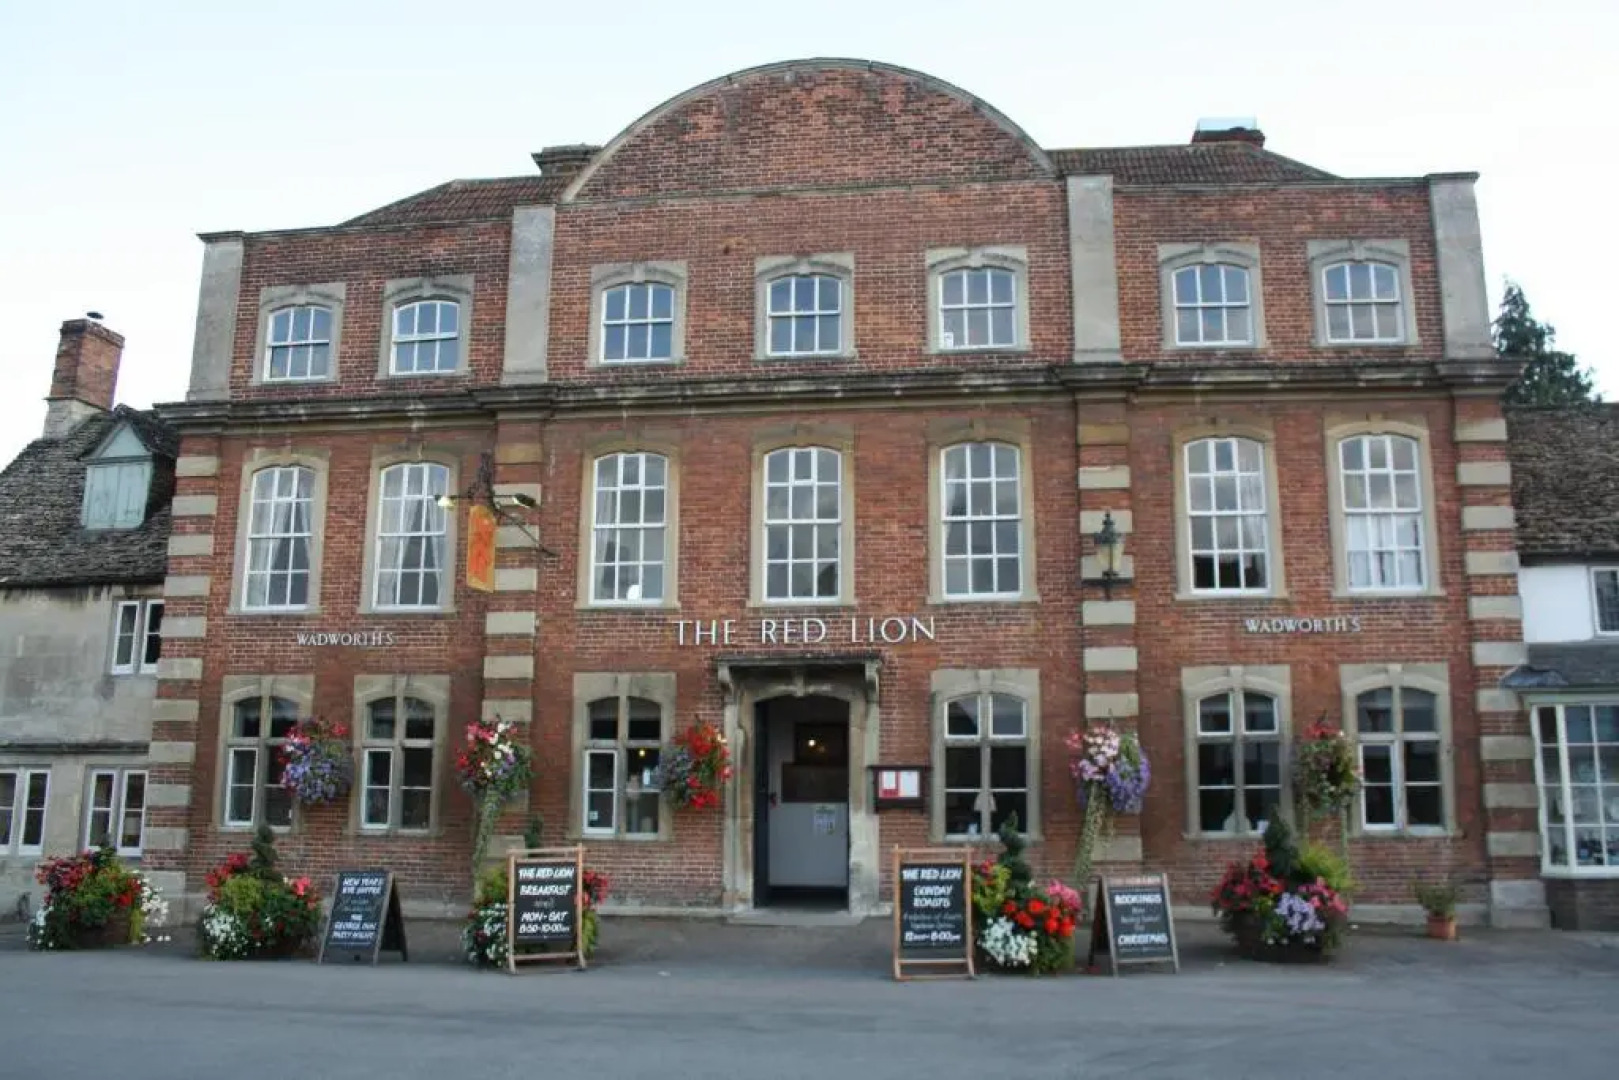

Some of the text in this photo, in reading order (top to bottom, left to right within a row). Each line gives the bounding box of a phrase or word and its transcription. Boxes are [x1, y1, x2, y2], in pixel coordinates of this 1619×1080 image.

[674, 615, 936, 645] THE RED LION
[519, 866, 575, 879] THE RED LION
[902, 866, 962, 880] THE RED LION
[519, 884, 572, 896] BREAKFAST
[913, 884, 953, 896] SUNDAY
[913, 897, 951, 908] ROASTS
[521, 911, 543, 922] MON
[548, 911, 569, 922] SAT
